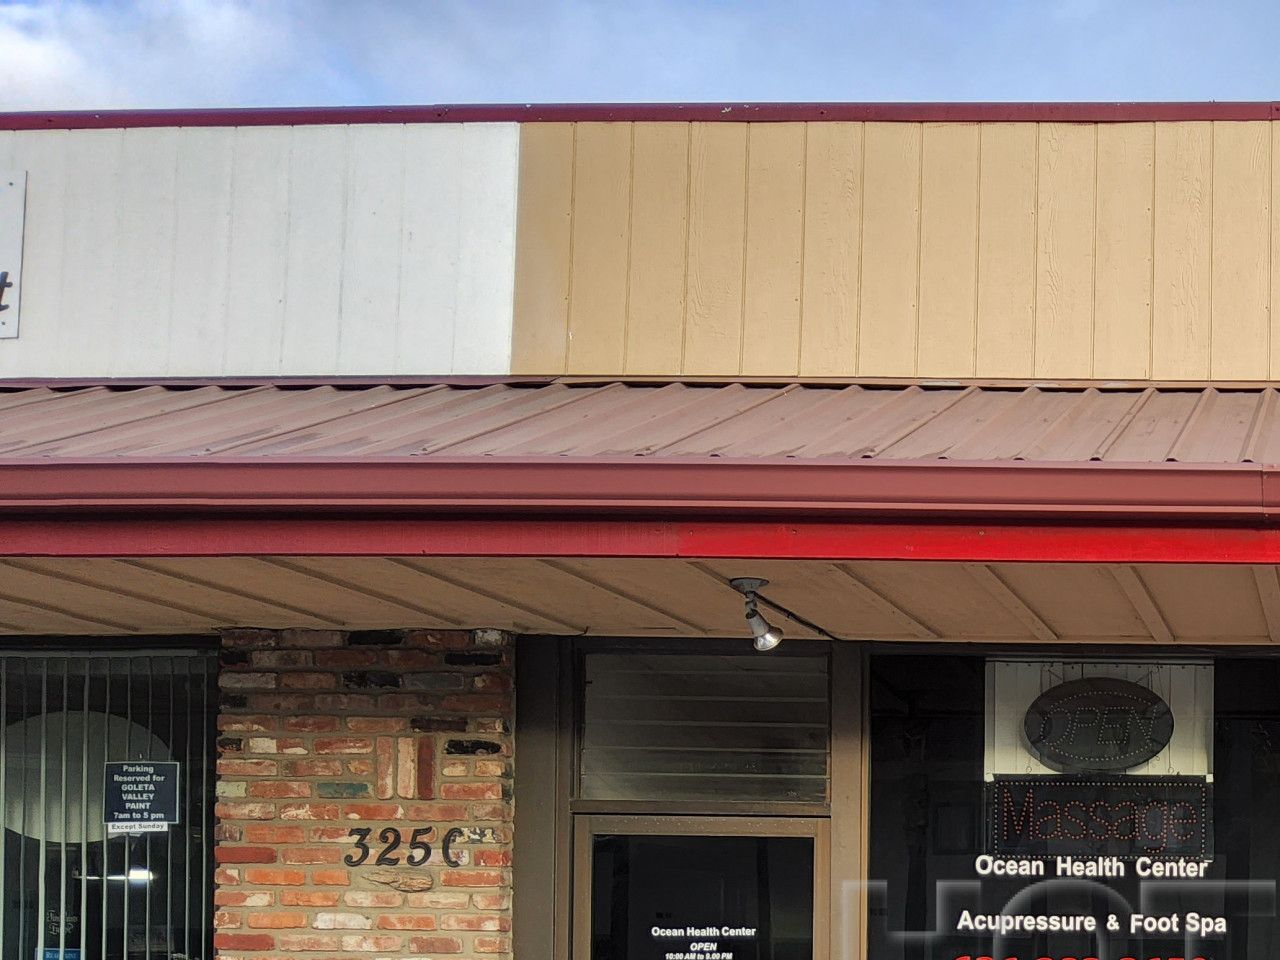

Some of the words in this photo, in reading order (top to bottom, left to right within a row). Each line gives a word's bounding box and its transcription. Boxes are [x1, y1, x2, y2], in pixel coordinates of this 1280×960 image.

[1039, 702, 1158, 747] OPEN
[123, 765, 154, 774] Parking
[1003, 788, 1197, 853] Massage
[975, 854, 1044, 877] Ocean
[1056, 856, 1125, 877] Health
[1135, 856, 1208, 878] Center
[651, 926, 685, 937] Ocean
[686, 926, 720, 937] Health
[721, 926, 756, 937] Center
[957, 910, 1097, 934] Acupressure
[1106, 913, 1120, 930] &
[1130, 913, 1180, 933] Foot
[1185, 912, 1227, 937] Spa
[690, 942, 718, 951] OPEN
[665, 952, 684, 960] 10:00
[684, 952, 697, 960] AM
[721, 952, 733, 960] PM
